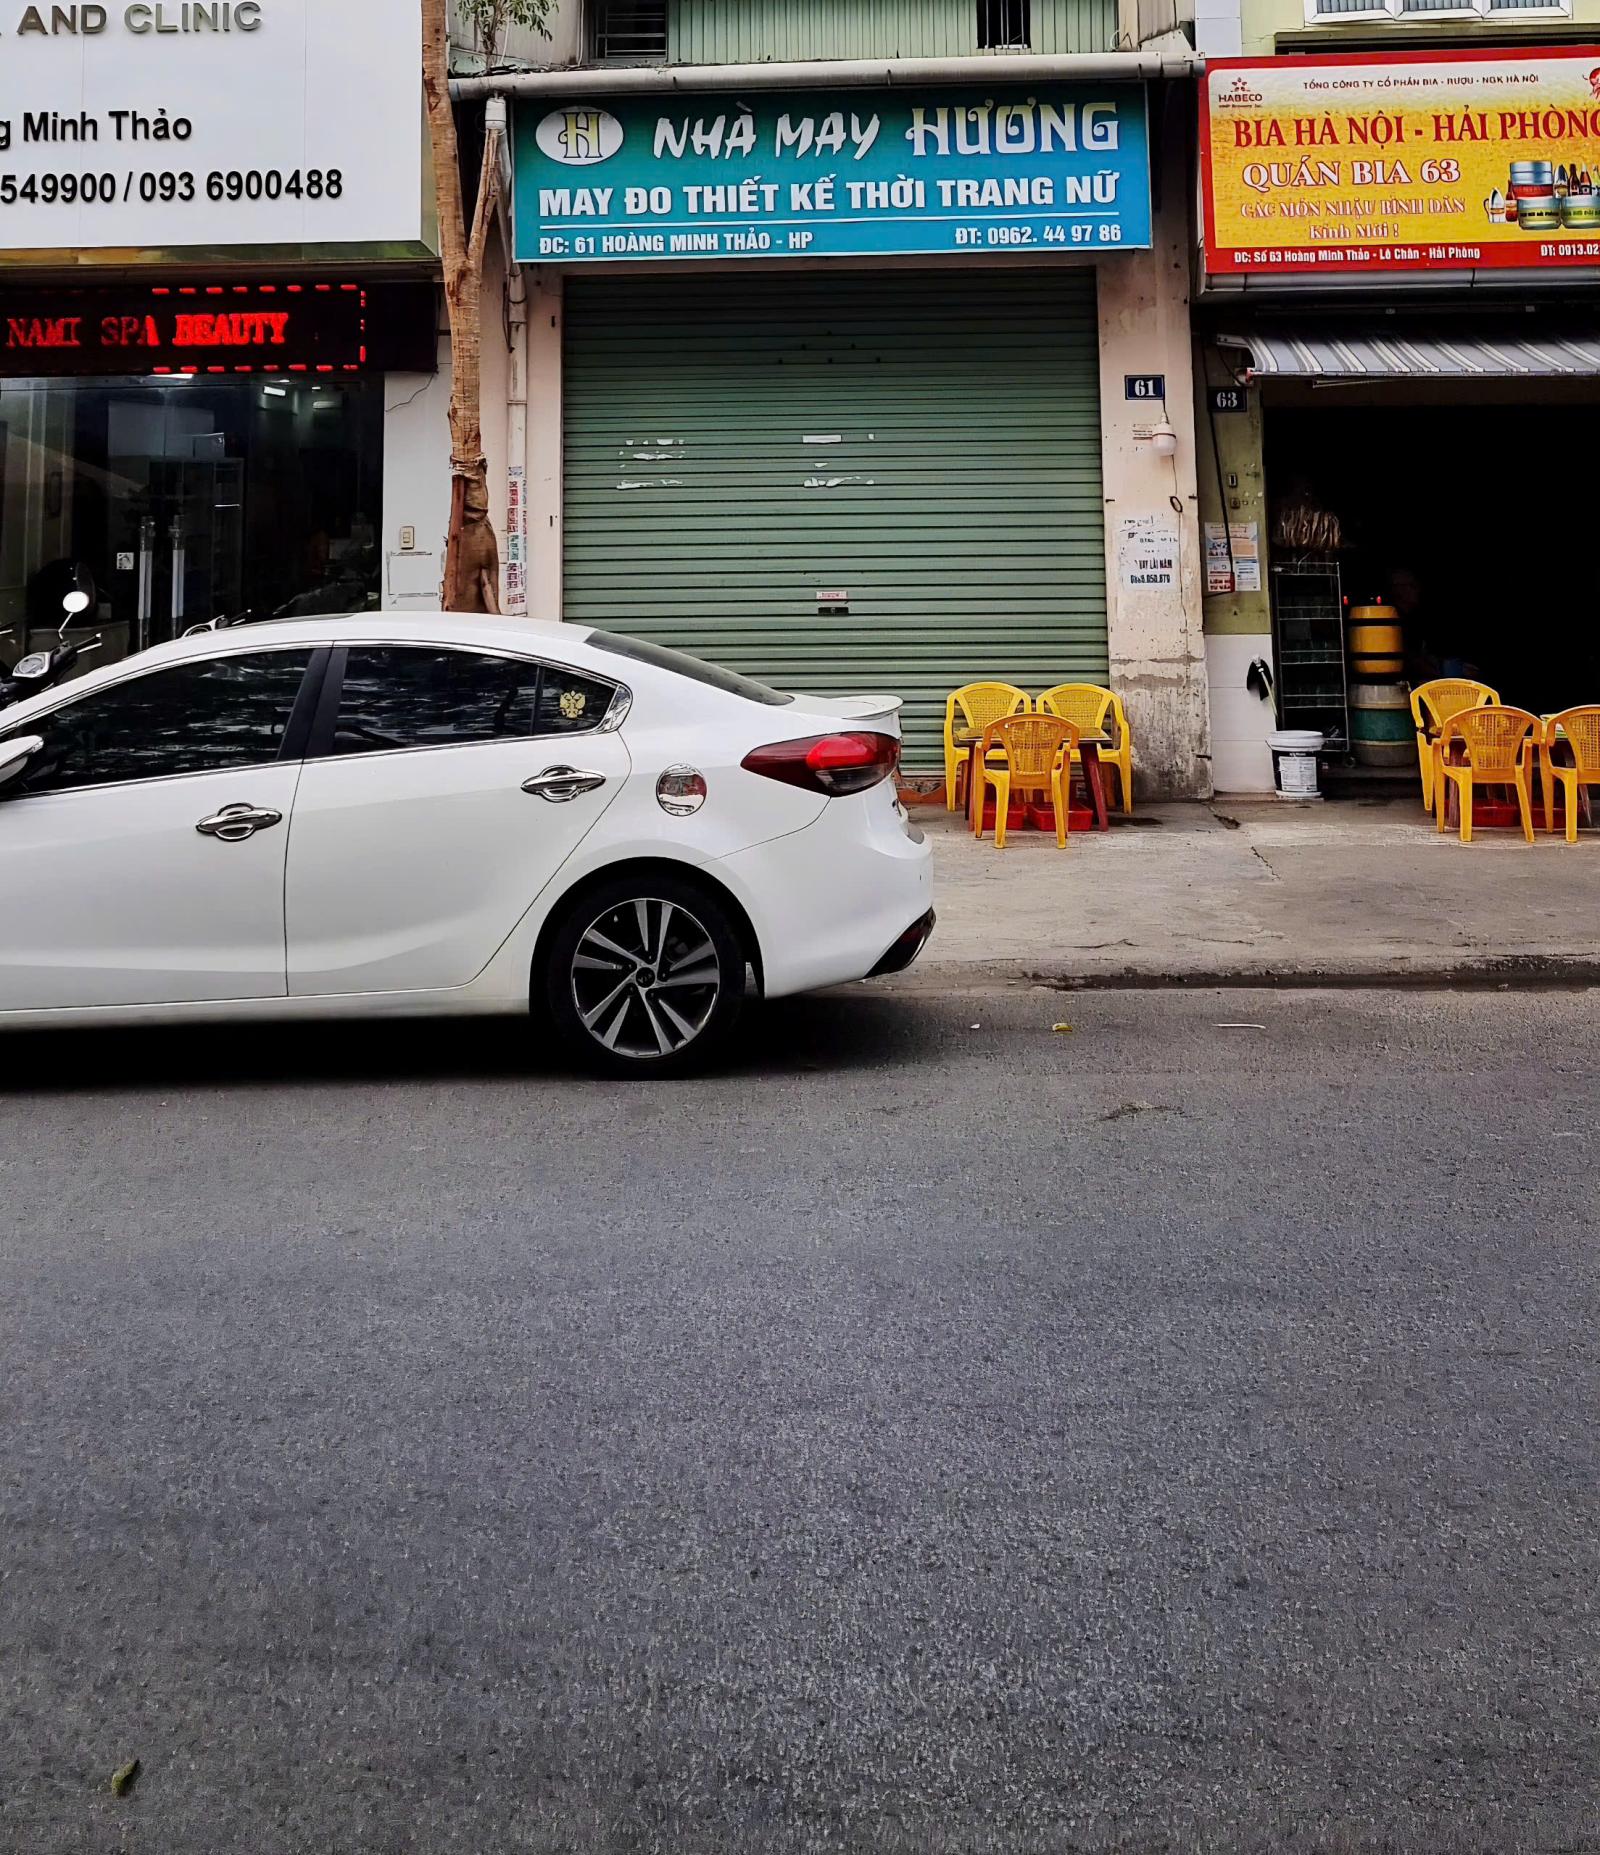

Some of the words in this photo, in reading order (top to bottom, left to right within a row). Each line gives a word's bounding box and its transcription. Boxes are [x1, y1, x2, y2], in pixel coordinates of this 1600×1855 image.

[16, 4, 107, 35] AND
[124, 2, 262, 33] CLINIC
[1506, 74, 1519, 83] HÀ
[23, 111, 98, 142] Minh
[108, 109, 193, 141] Thảo
[558, 111, 603, 158] H
[653, 101, 757, 160] NHÀ
[775, 112, 880, 161] MAY
[905, 97, 1119, 157] HƯƠNG
[1233, 118, 1286, 148] BIA
[1293, 110, 1341, 146] HÀ
[1346, 110, 1405, 150] NỘI
[1431, 104, 1489, 142] HẢI
[138, 171, 196, 202] 093
[206, 169, 343, 201] 6900488
[1242, 155, 1340, 193] QUÁN
[1352, 160, 1412, 185] BIA
[1420, 158, 1461, 183] 63
[539, 187, 613, 217] MAY
[624, 186, 672, 215] ĐO
[683, 175, 779, 213] THIẾT
[791, 173, 836, 211] KẾ
[846, 174, 925, 209] THỜI
[937, 177, 1053, 206] TRANG
[1066, 170, 1120, 204] NỮ
[539, 237, 569, 254] ĐC:
[575, 236, 595, 253] 61
[602, 231, 664, 252] HOÀNG
[670, 234, 719, 251] MINH
[723, 227, 771, 250] THẢO
[788, 233, 813, 249] HP
[955, 229, 982, 244] ĐT:
[988, 227, 1038, 244] 0962.
[1043, 227, 1065, 242] 44
[1071, 226, 1093, 241] 97
[1099, 225, 1121, 241] 86
[1254, 250, 1267, 262] Số
[1284, 250, 1316, 262] Hoàng
[1318, 250, 1344, 261] Minh
[1346, 248, 1370, 260] Thảo
[1448, 246, 1480, 259] Phòng
[6, 317, 81, 347] NAMI
[101, 315, 160, 346] SPA
[172, 313, 289, 346] BEAUTY
[1134, 380, 1157, 397] 61
[1216, 391, 1238, 408] 63
